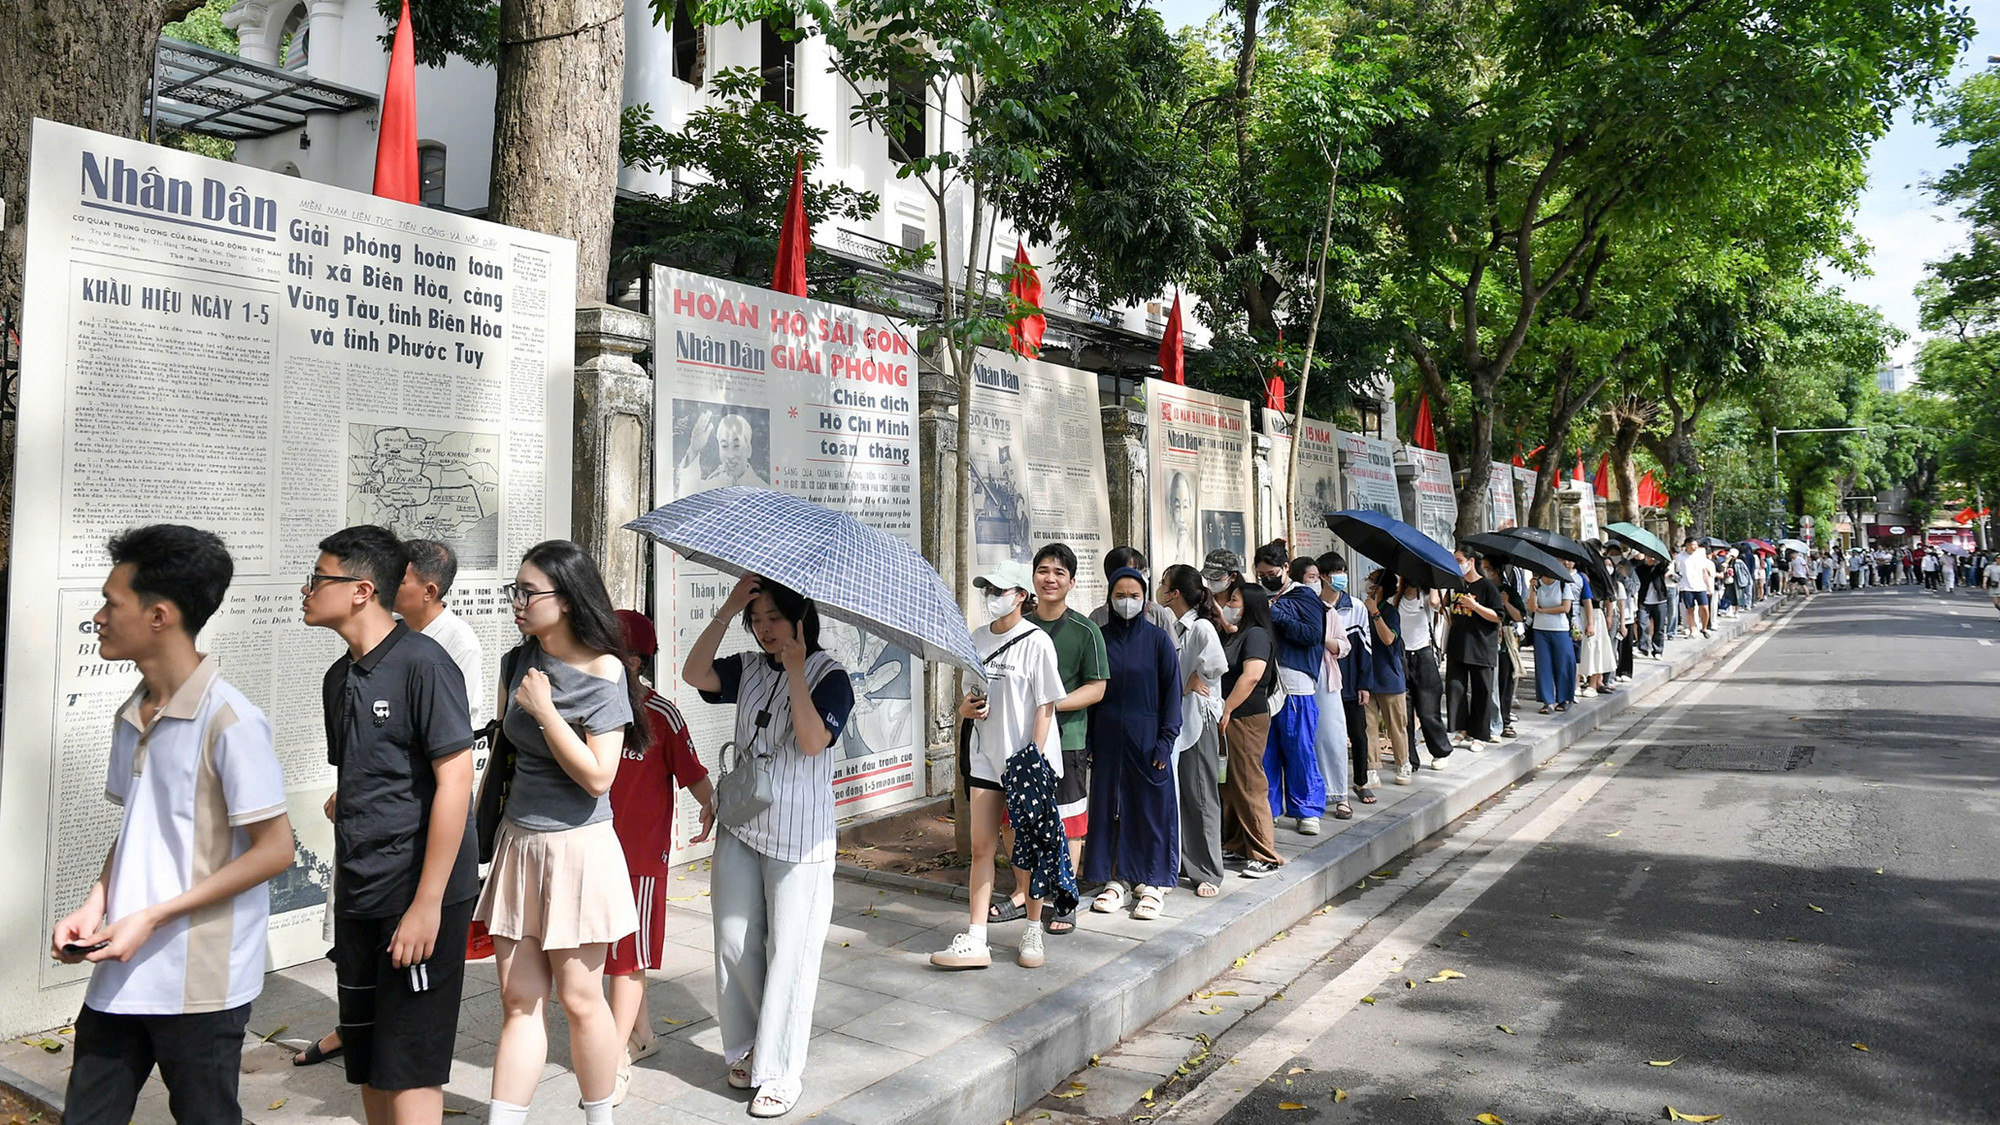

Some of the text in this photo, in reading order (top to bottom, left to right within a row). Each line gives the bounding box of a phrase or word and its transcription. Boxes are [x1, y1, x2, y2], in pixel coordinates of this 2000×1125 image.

[81, 151, 276, 232] Nhân Dân
[327, 207, 346, 216] NAM
[422, 227, 445, 237] CÔNG
[290, 219, 502, 280] Giải phóng hoàn toàn
[83, 278, 269, 325] KHẦU HIỆU NGÀY 1-5
[288, 253, 312, 279] thị
[326, 264, 351, 283] xã
[363, 265, 402, 292] Biên
[414, 274, 452, 304] Hòa,
[464, 287, 502, 312] cảng
[288, 285, 339, 318] Vũng
[346, 295, 384, 325] Tàu,
[429, 308, 464, 333] Biên
[471, 315, 501, 338] Hòa
[674, 290, 758, 329] HOAN
[771, 309, 807, 336] HÔ
[863, 327, 908, 355] GÒN
[311, 328, 483, 369] và tỉnh Phước Tuy
[677, 330, 764, 370] Nhân Dân
[771, 344, 907, 386] GIẢI PHÓNG
[974, 363, 1019, 390] Nhân Dân
[833, 389, 908, 412] Chiến dịch
[820, 412, 909, 436] Hồ Chí Minh
[1306, 426, 1314, 441] 15
[252, 617, 267, 625] Gia
[833, 789, 844, 800] ao
[864, 782, 876, 792] 1-5
